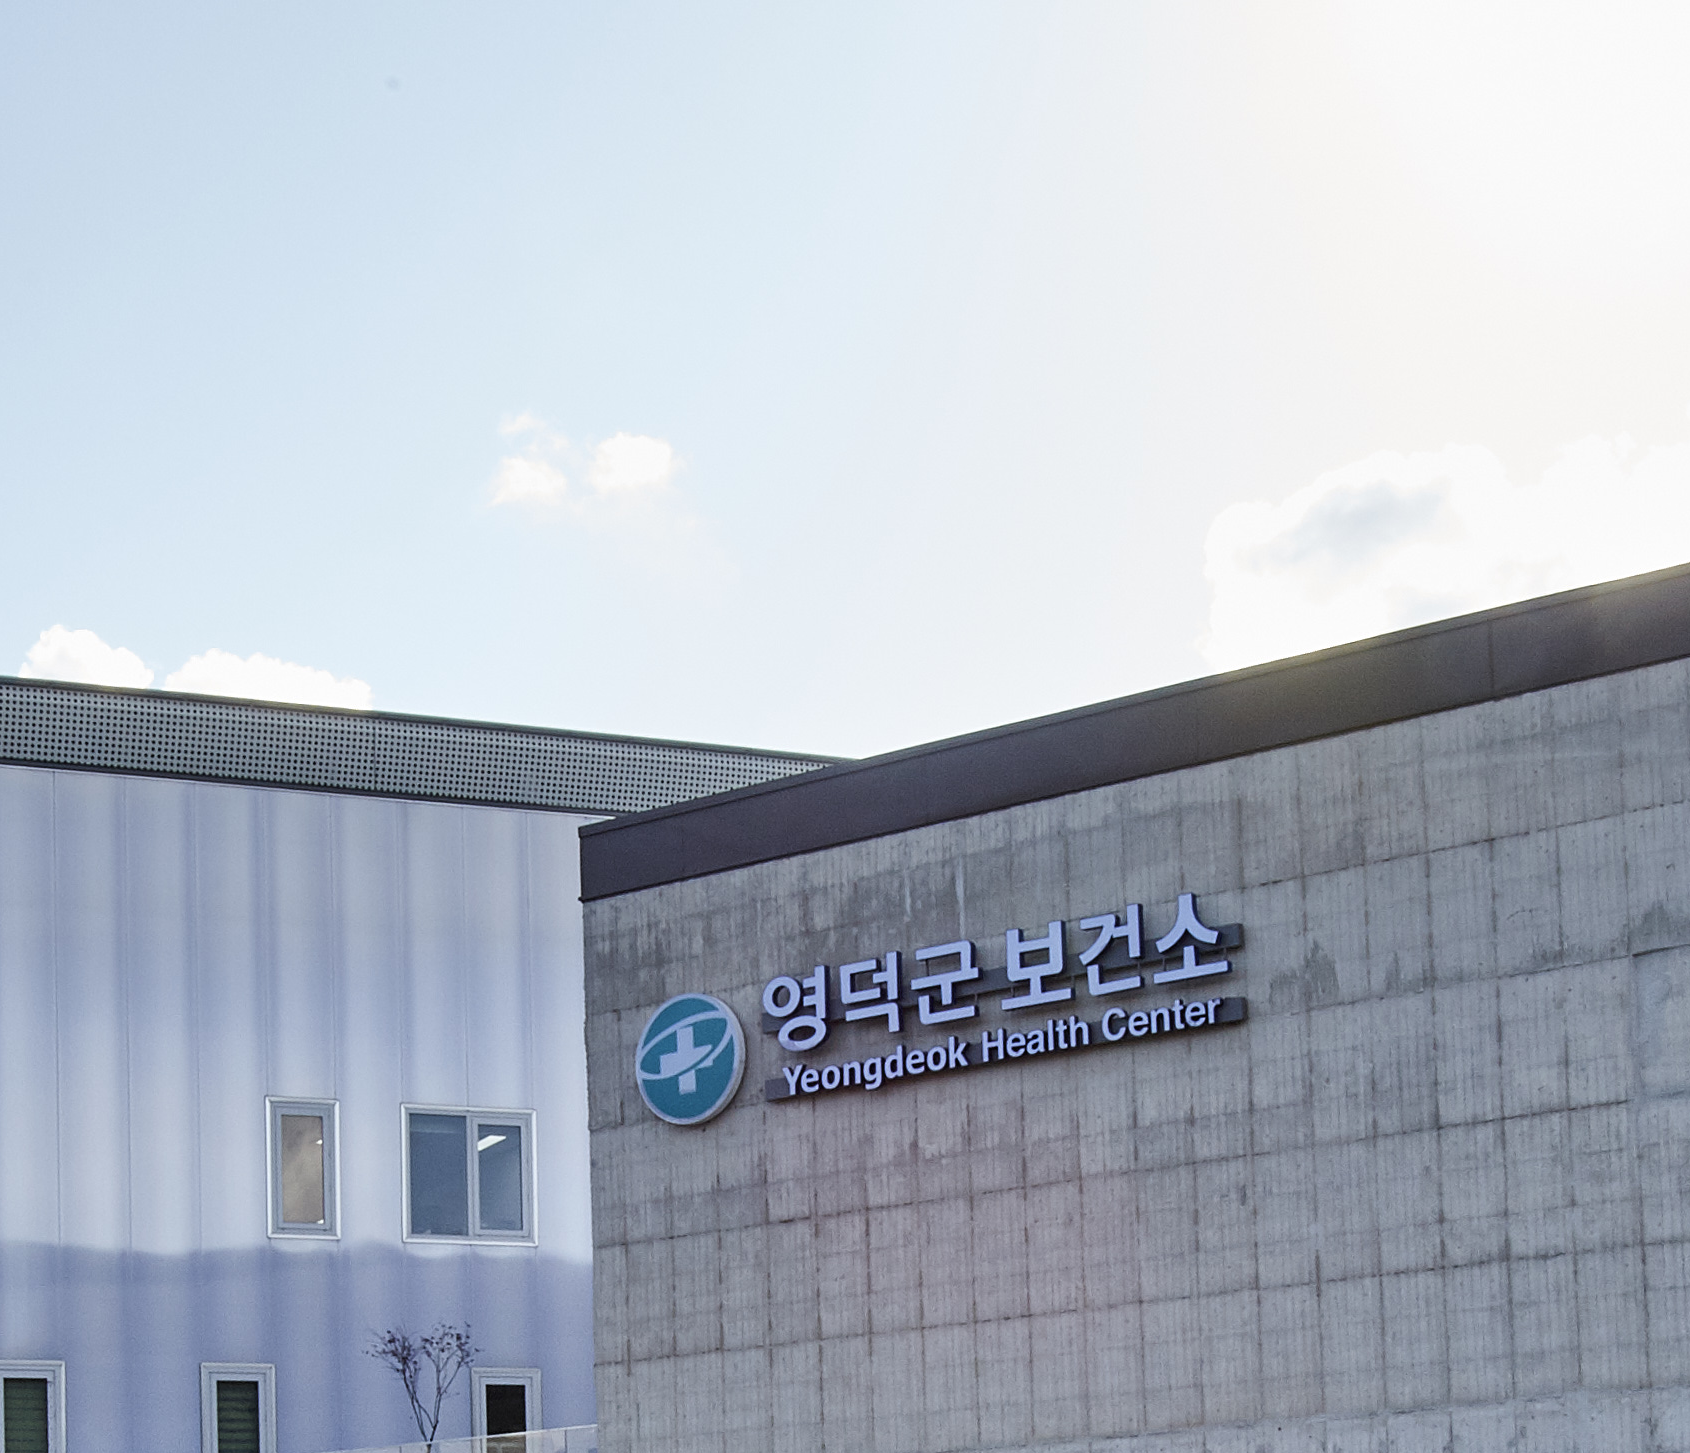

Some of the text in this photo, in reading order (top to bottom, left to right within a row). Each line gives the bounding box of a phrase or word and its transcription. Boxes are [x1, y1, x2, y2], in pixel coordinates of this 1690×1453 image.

[762, 892, 1232, 1053] 영덕군 보건소
[781, 999, 1225, 1096] Yeongdeok Health Center
